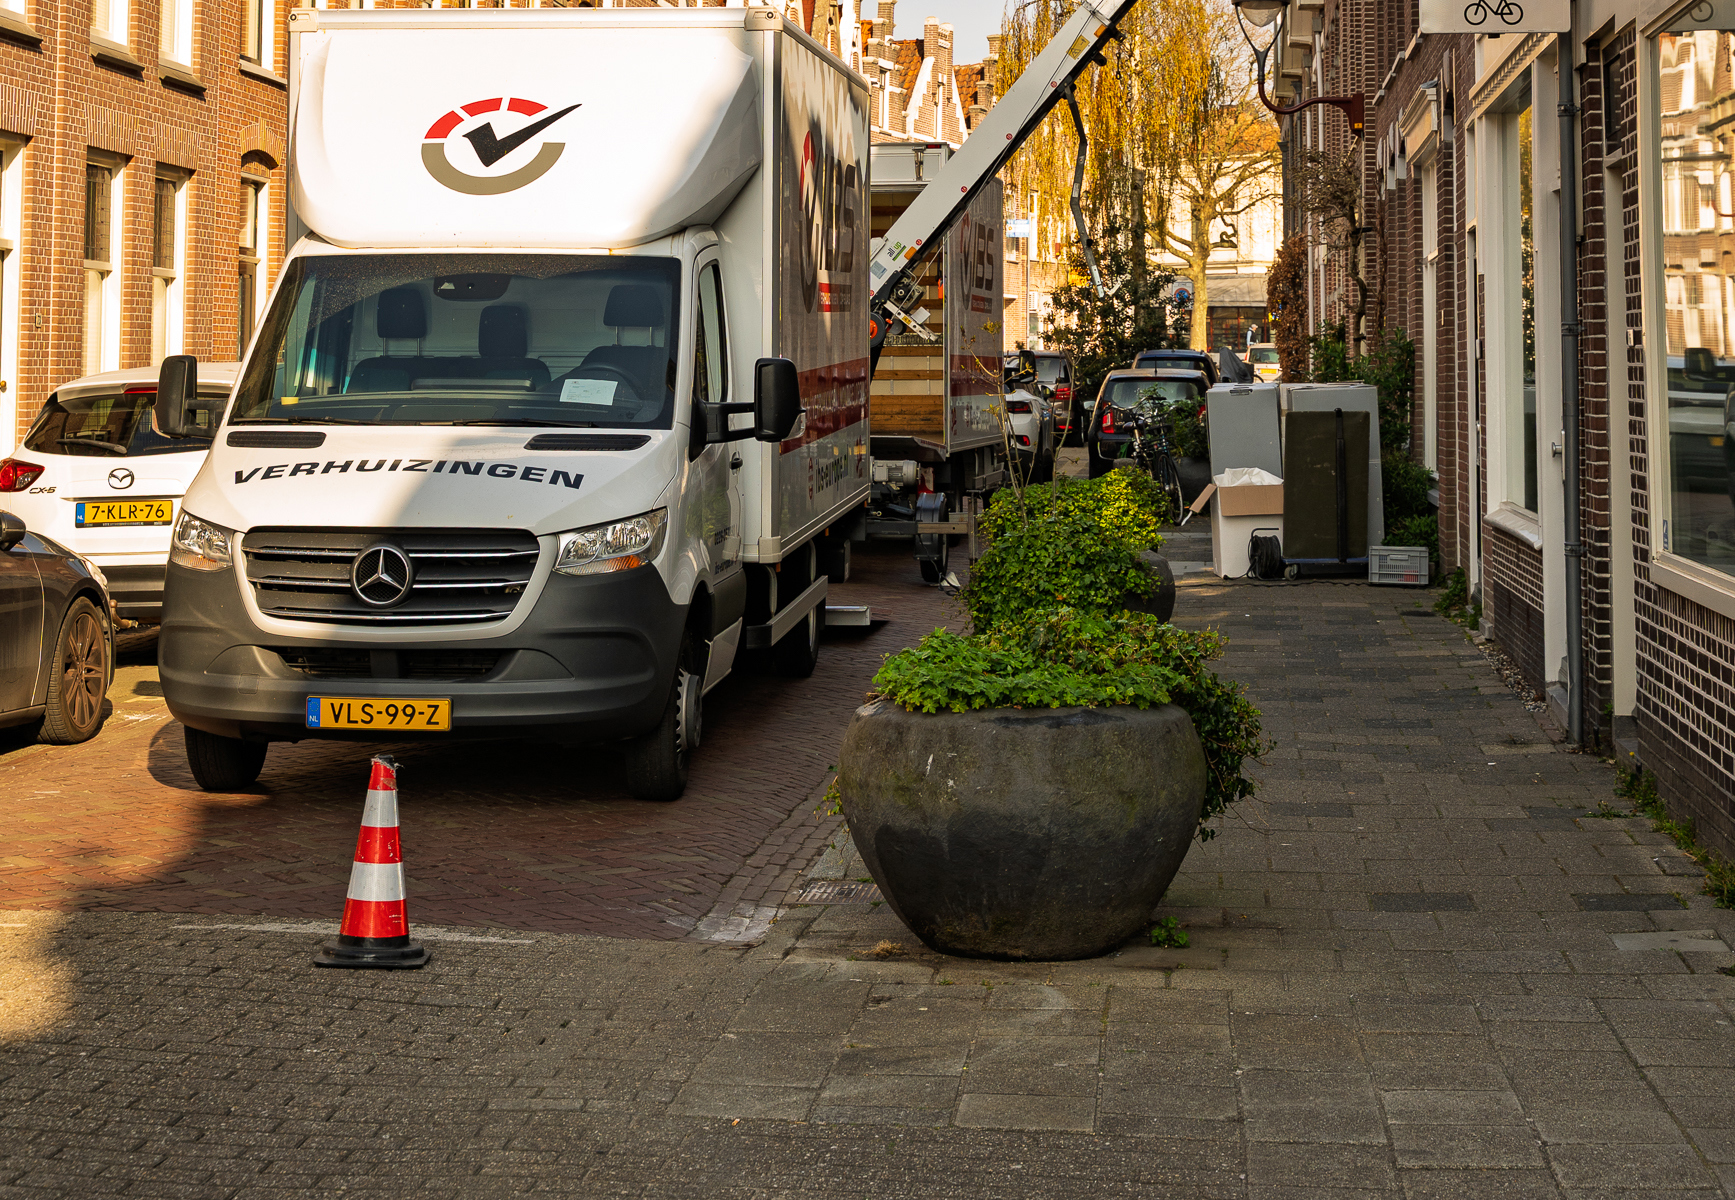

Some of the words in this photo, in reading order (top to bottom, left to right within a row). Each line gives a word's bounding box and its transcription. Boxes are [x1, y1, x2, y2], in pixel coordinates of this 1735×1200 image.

[972, 221, 995, 292] IBS
[234, 458, 586, 490] VERHUIZINGEN
[29, 486, 57, 494] CX-5
[91, 504, 165, 520] 7-KLR-76
[309, 715, 319, 723] NL
[330, 702, 440, 726] VLS-99-Z
